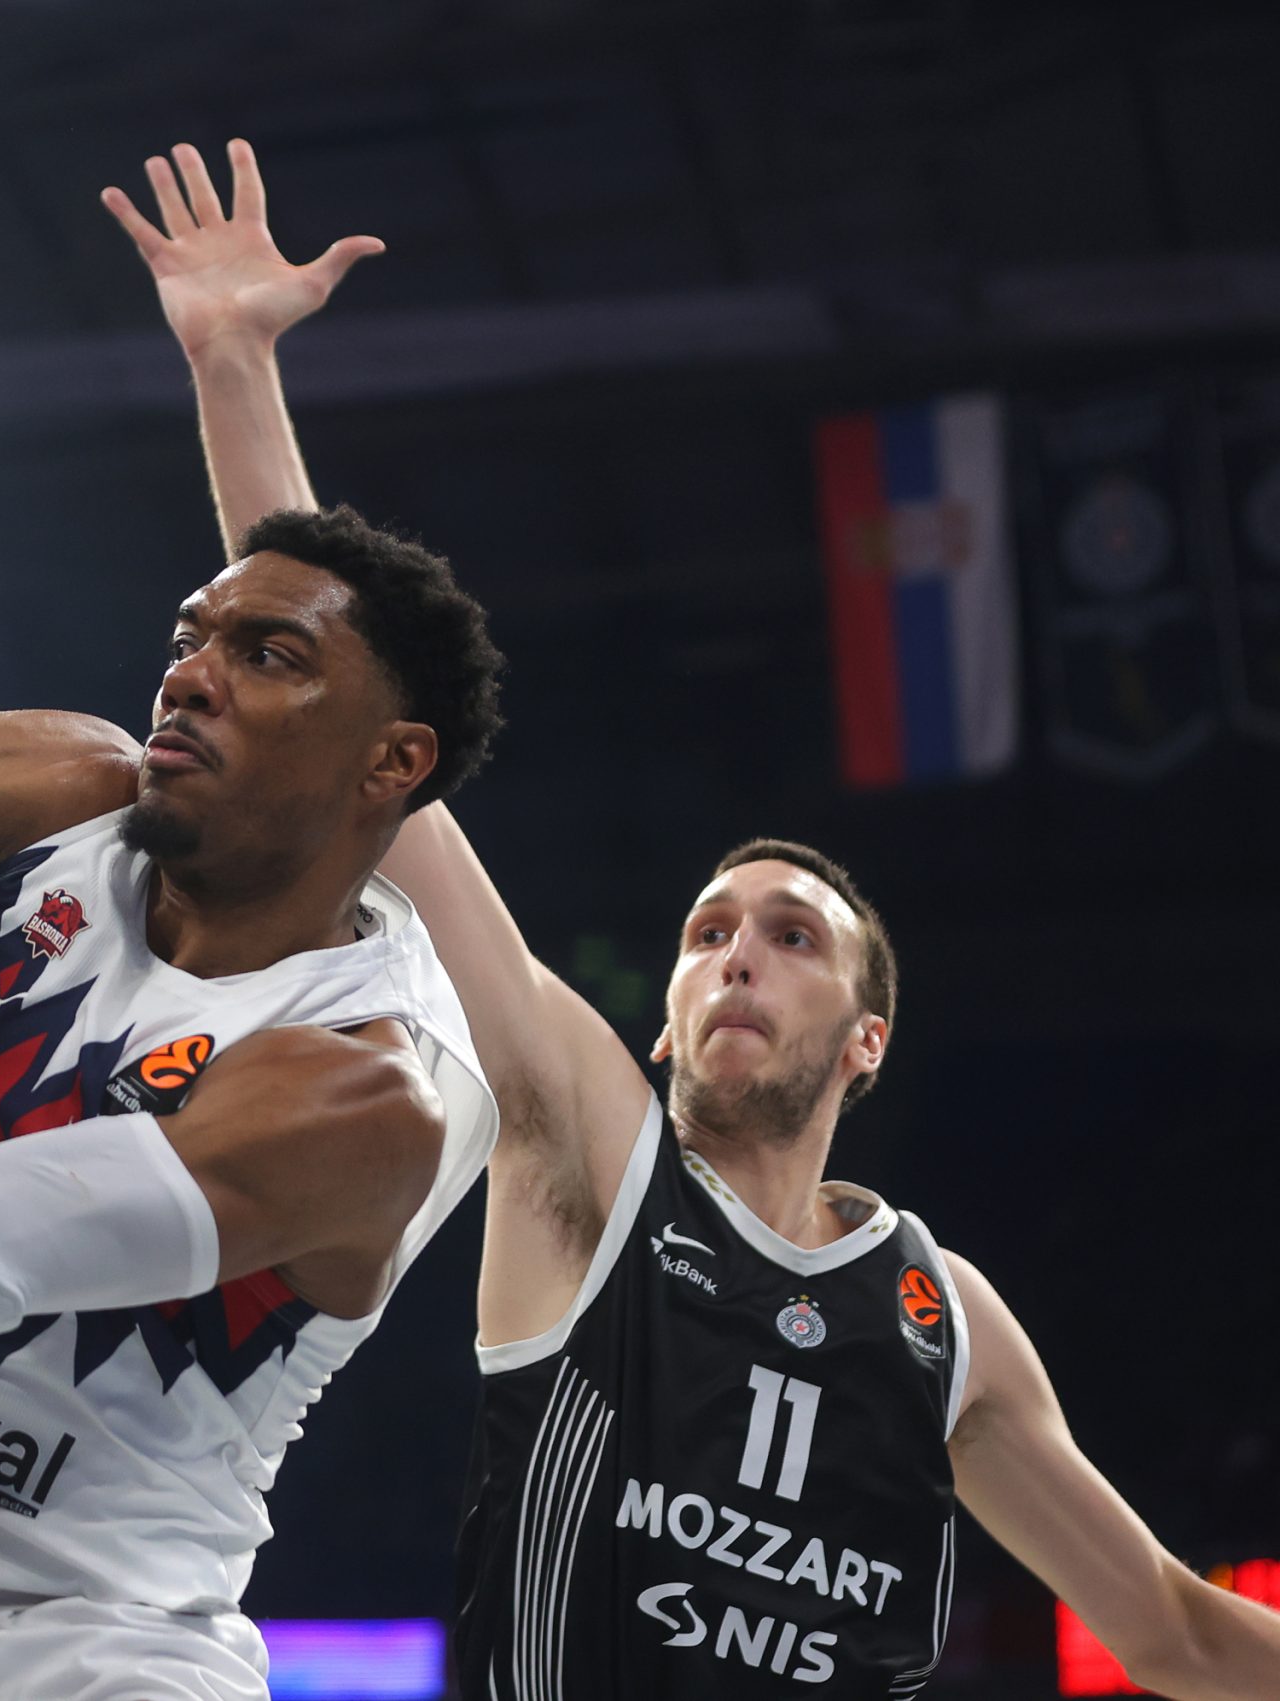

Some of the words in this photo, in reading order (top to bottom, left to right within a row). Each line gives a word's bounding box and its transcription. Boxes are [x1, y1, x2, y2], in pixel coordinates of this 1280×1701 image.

[660, 1253, 718, 1295] ikBank
[737, 1364, 822, 1501] 11
[615, 1478, 903, 1615] MOZZART
[715, 1605, 838, 1684] NIS
